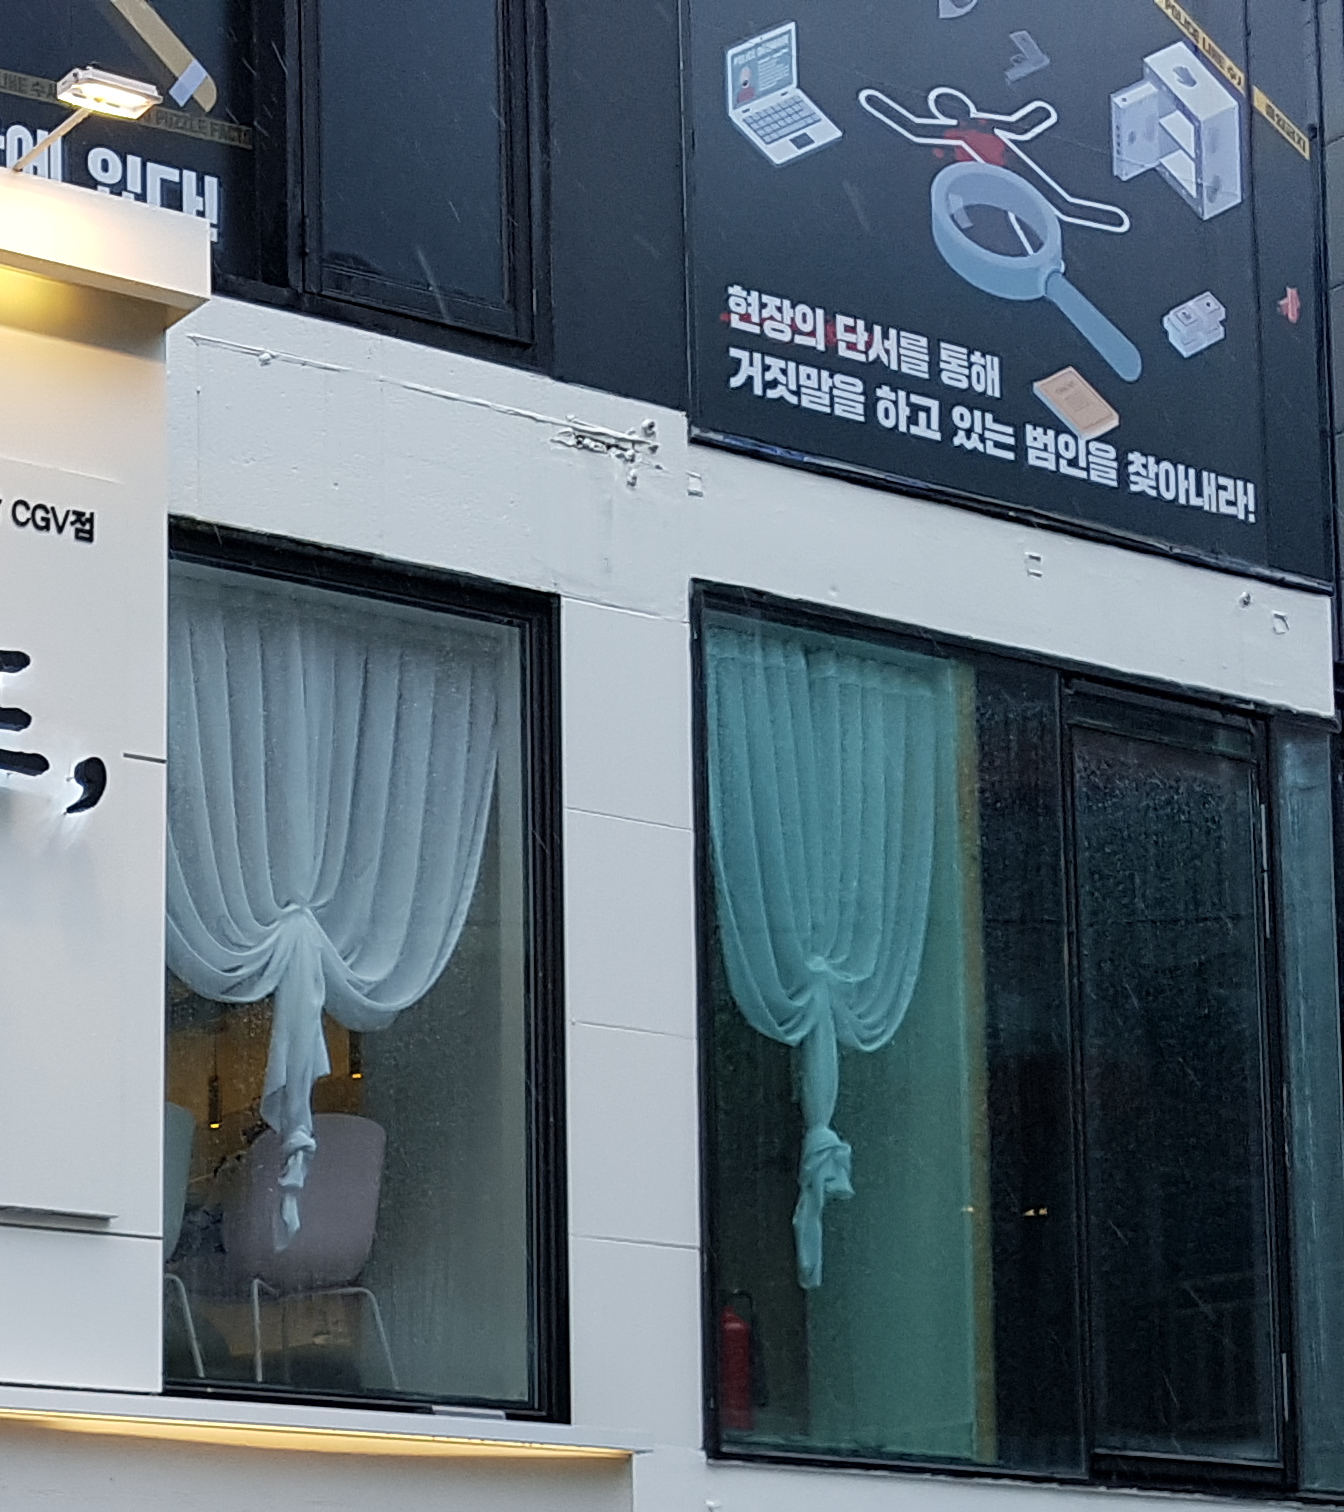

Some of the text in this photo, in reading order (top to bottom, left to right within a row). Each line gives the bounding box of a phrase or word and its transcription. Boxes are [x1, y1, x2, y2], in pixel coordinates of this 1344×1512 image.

[727, 284, 1001, 398] 현장의 단서를 통해
[729, 347, 1256, 523] 거짓말을 하고 있는 범인을 찾아내라!
[12, 499, 95, 544] CGV점
